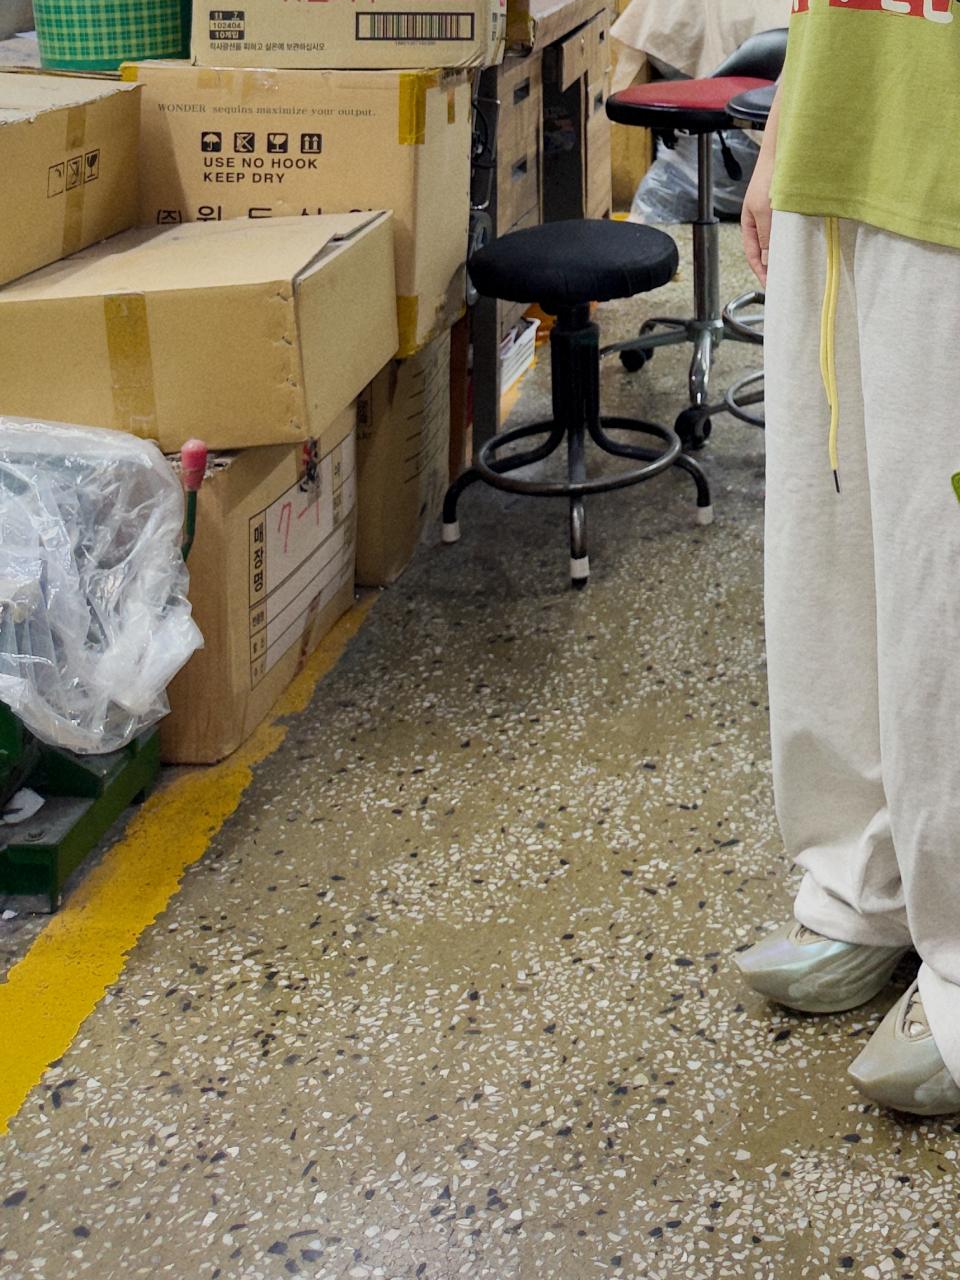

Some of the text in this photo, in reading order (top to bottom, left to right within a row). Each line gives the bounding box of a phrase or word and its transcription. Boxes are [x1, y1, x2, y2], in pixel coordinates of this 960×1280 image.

[157, 103, 376, 117] WONDER sequins maximize your output.
[203, 157, 318, 169] USE NO HOOK
[203, 172, 285, 183] KEEP DRY
